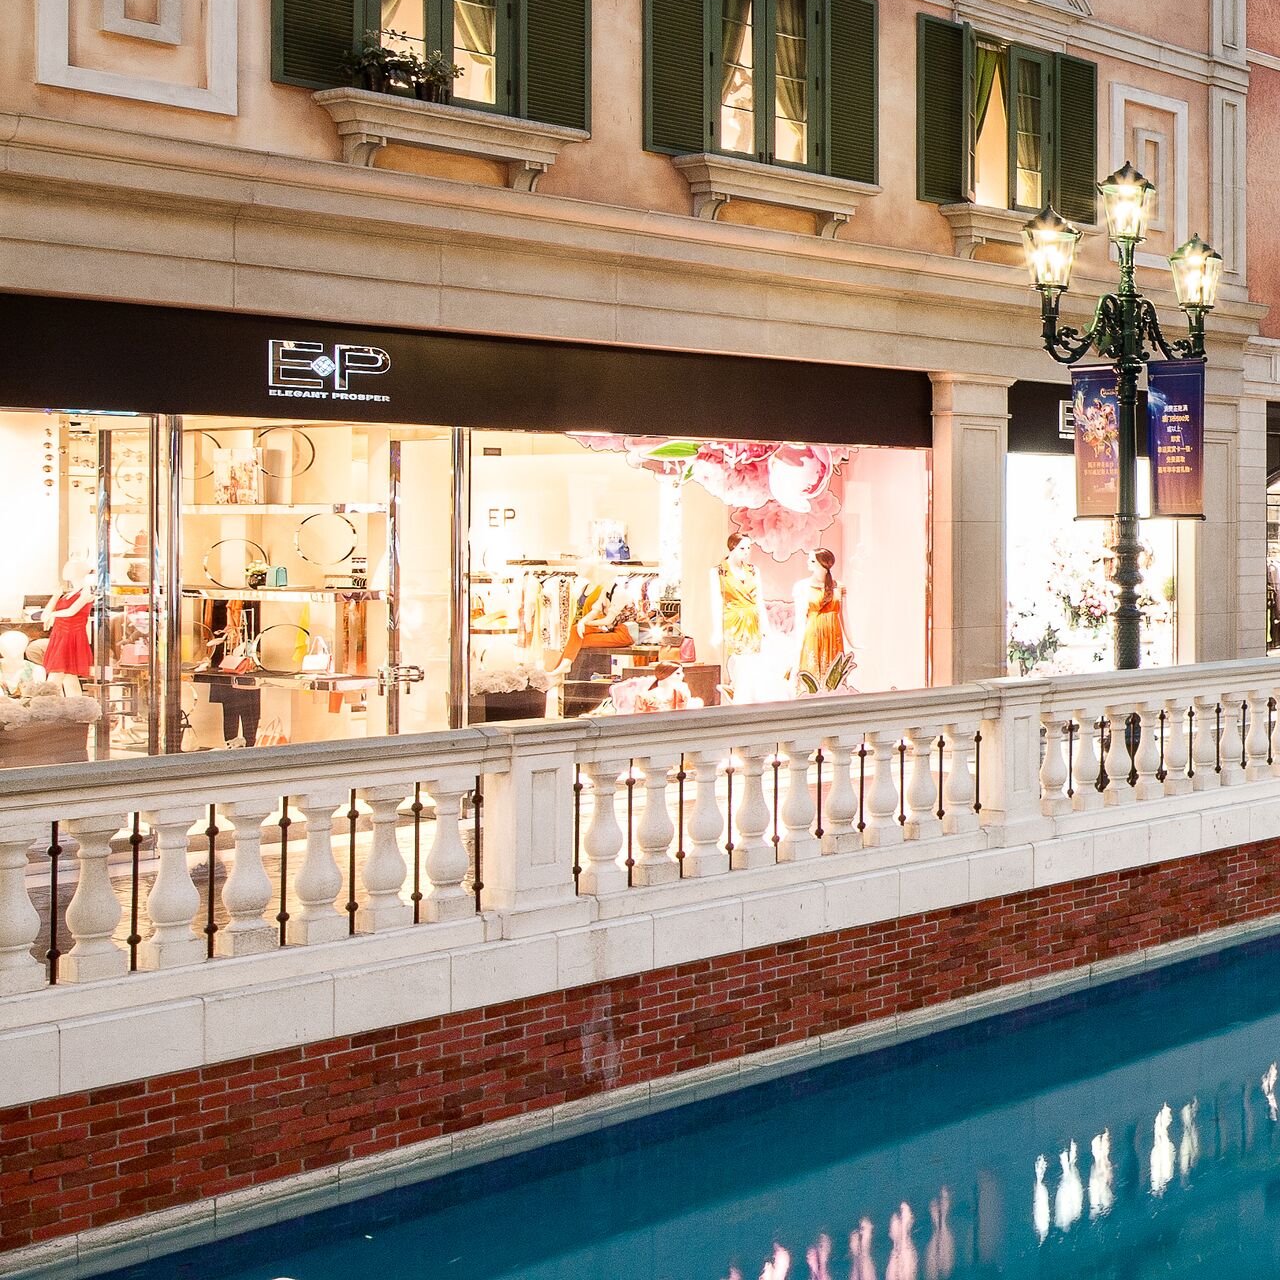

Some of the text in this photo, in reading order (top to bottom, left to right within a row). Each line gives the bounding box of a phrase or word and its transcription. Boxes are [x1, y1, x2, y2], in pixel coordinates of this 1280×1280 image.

[269, 389, 390, 402] ELEGANT PROSPER
[488, 508, 516, 527] EP
